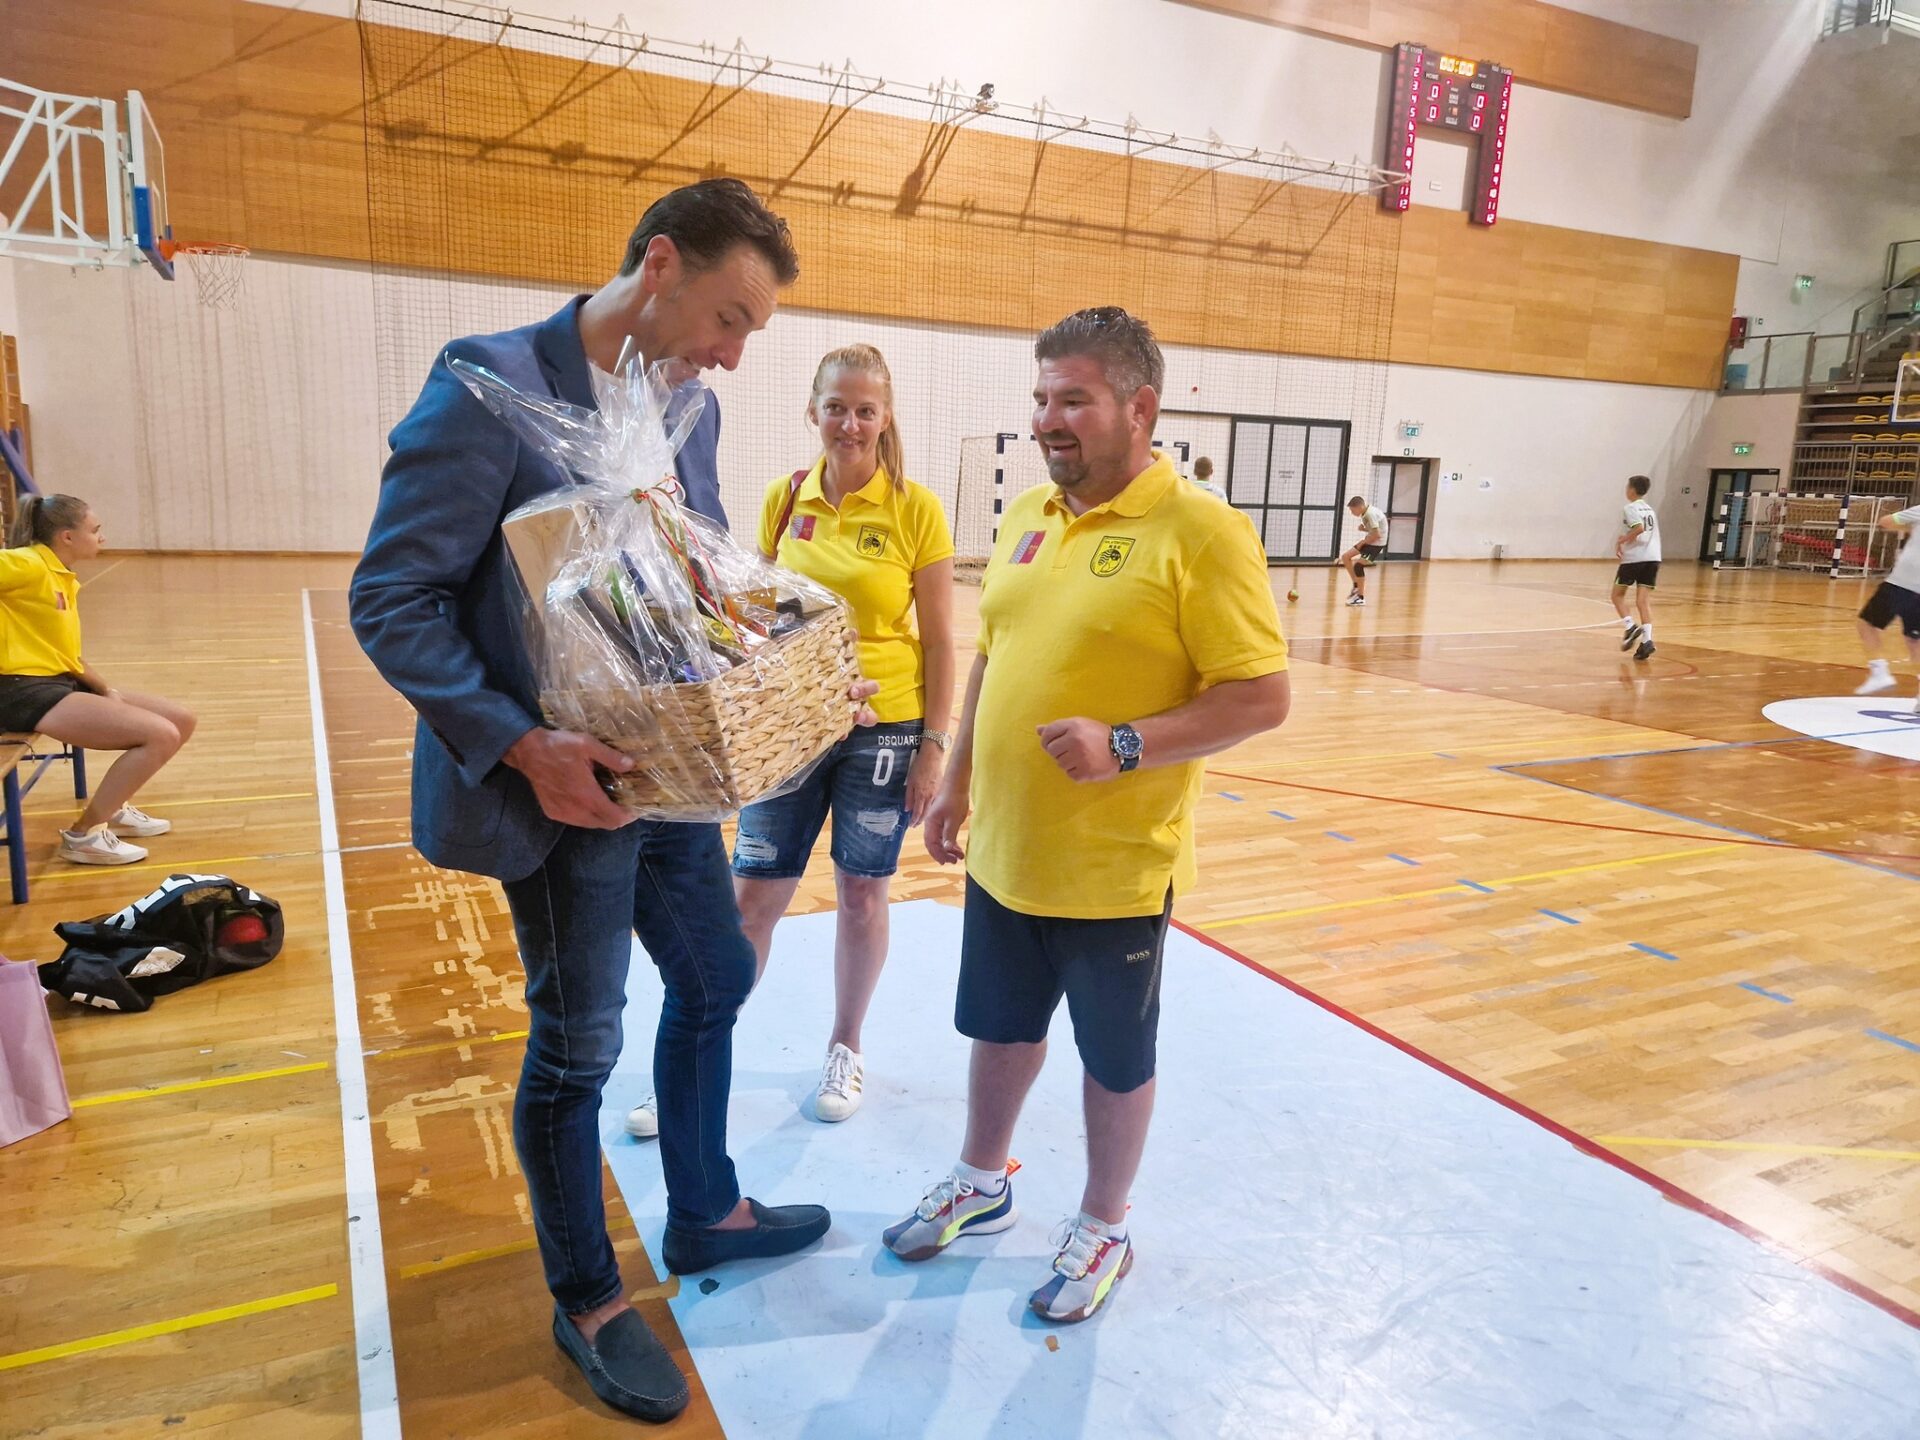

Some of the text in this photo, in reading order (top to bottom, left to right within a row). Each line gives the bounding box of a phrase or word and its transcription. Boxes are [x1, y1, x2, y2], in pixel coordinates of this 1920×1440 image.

[1413, 67, 1420, 77] 2
[1412, 81, 1419, 90] 3
[1431, 85, 1439, 98] 0
[1503, 87, 1509, 97] 2
[1411, 94, 1418, 104] 4
[1476, 95, 1484, 108] 0
[1502, 100, 1507, 110] 3
[1410, 107, 1417, 117] 5
[1429, 106, 1437, 119] 0
[1472, 115, 1480, 128] 0
[1500, 113, 1506, 122] 4
[1408, 121, 1414, 131] 6
[1498, 125, 1504, 136] 5
[1496, 139, 1502, 148] 6
[1405, 160, 1411, 170] 9
[1400, 186, 1409, 196] 11
[1399, 199, 1408, 209] 12
[1487, 201, 1496, 210] 11
[1643, 514, 1654, 531] 19
[877, 735, 920, 746] DSQUARE
[1126, 950, 1150, 961] BOSS
